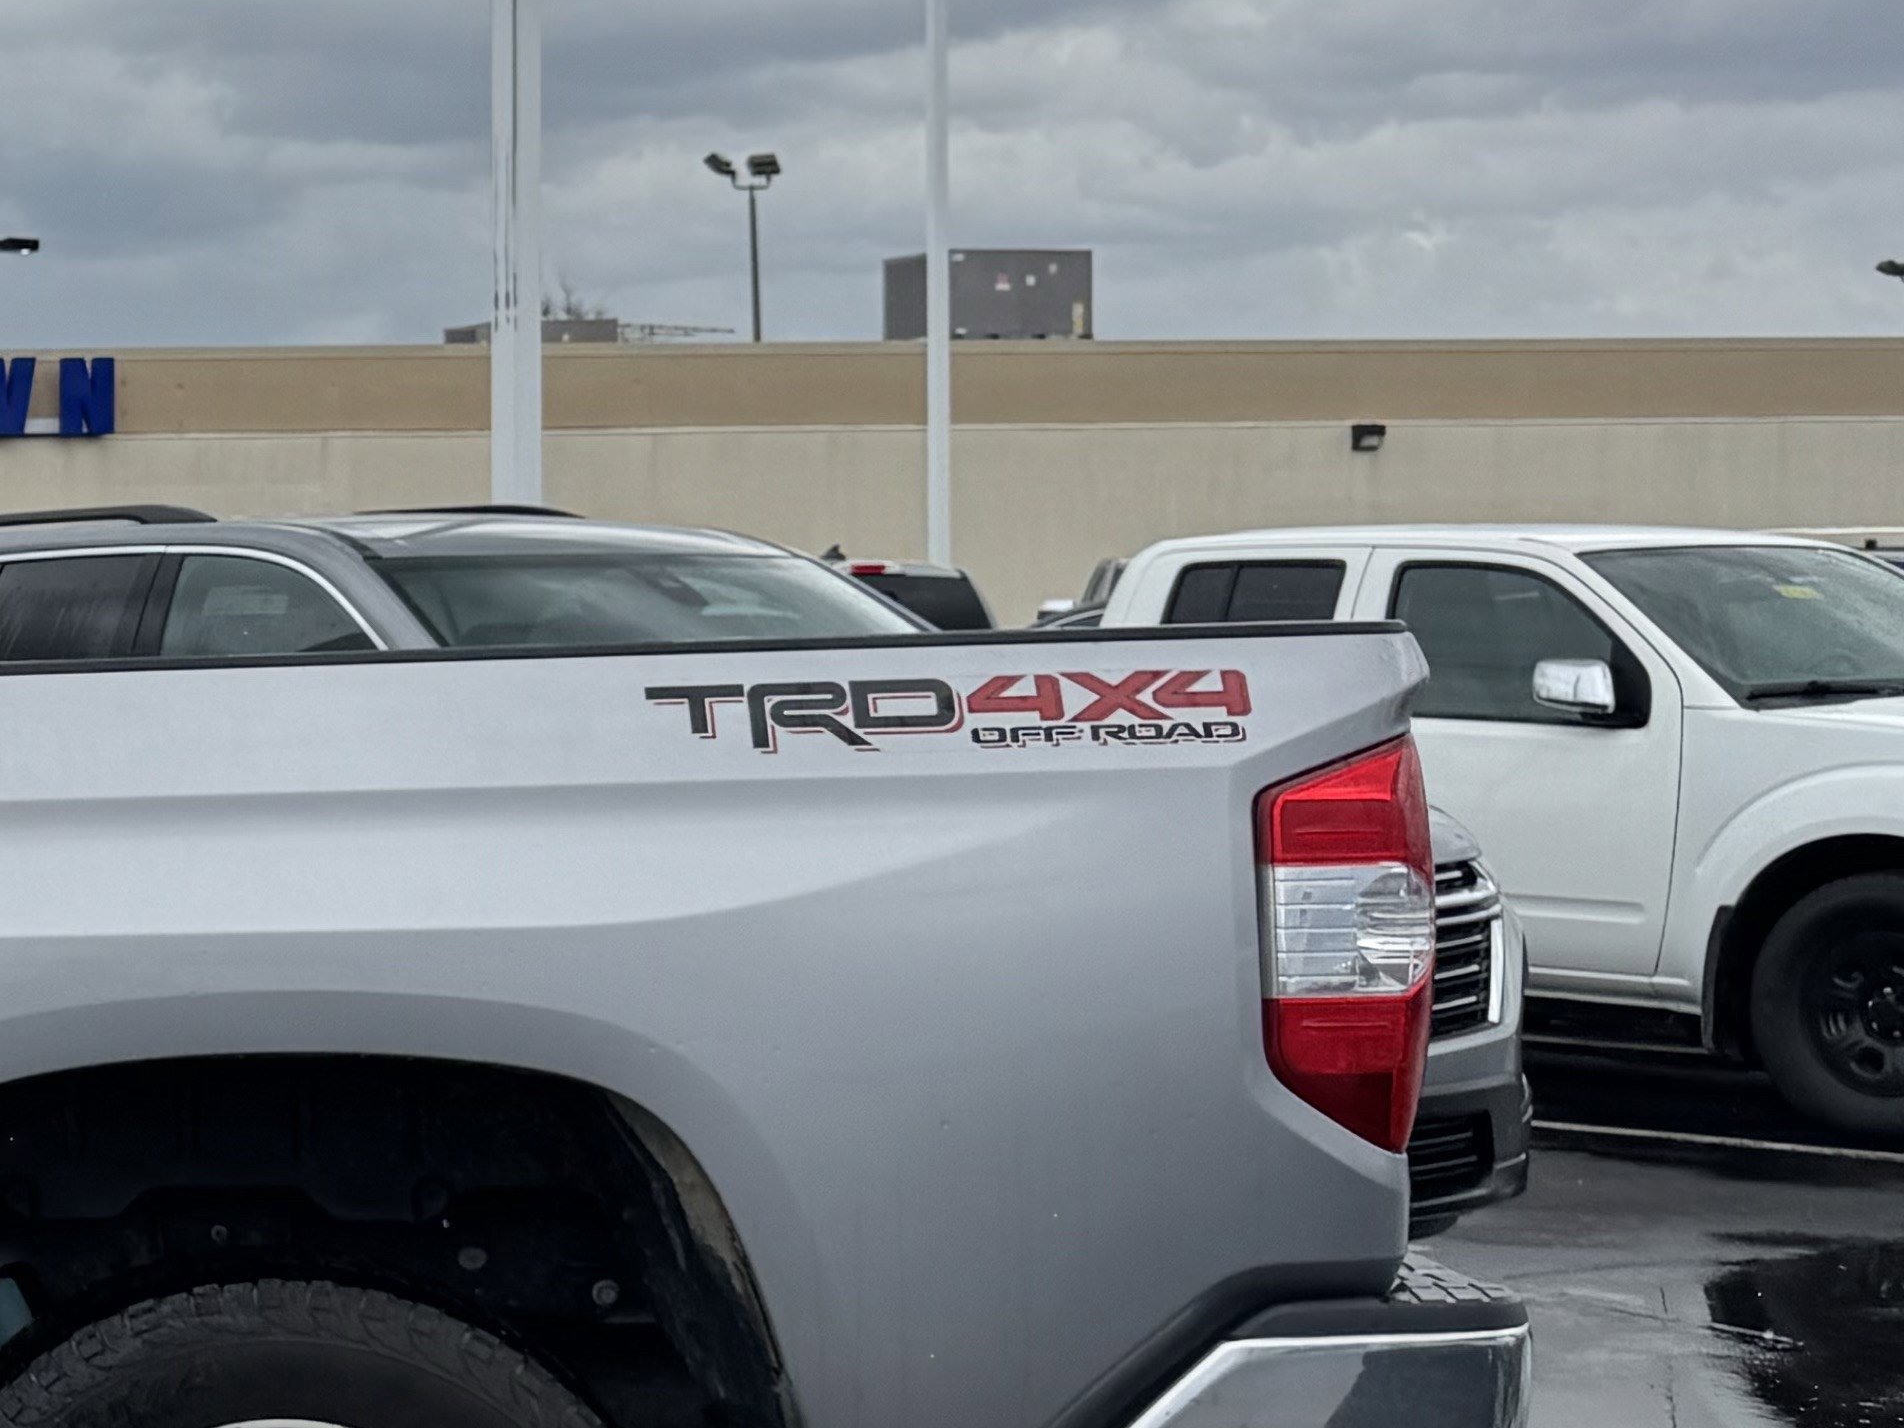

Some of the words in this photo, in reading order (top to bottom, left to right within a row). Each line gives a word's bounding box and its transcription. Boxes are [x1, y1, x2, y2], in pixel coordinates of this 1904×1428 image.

[645, 678, 965, 753] TRD
[967, 669, 1252, 722] 4X4
[971, 723, 1077, 748] OFF
[1090, 721, 1247, 746] ROAD
